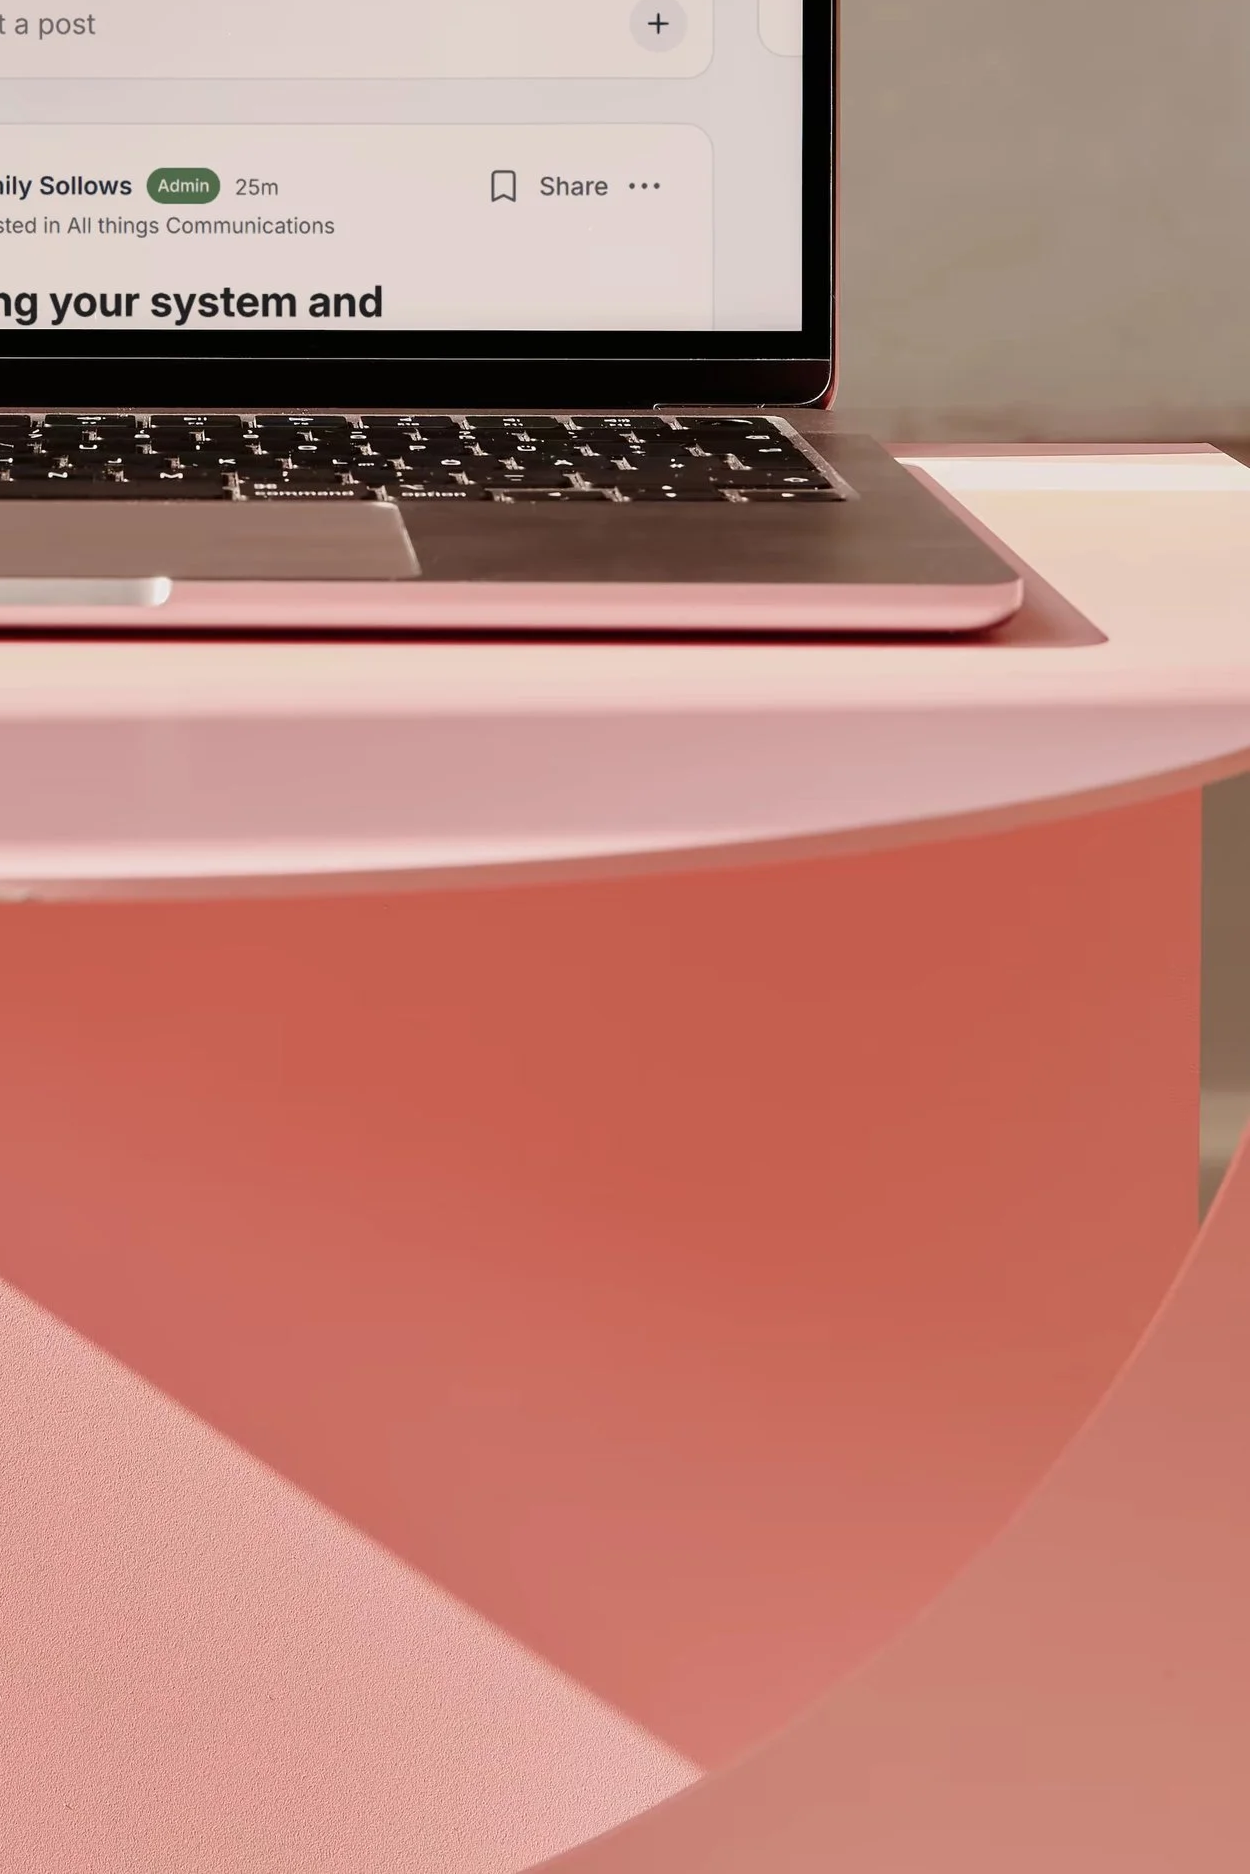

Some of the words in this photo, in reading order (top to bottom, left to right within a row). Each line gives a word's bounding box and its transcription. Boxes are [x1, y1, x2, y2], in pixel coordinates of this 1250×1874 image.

[14, 17, 29, 36] a
[38, 13, 96, 41] post
[39, 175, 133, 196] Sollows
[157, 177, 210, 194] Admin
[235, 178, 279, 196] 25m
[539, 176, 609, 197] Share
[43, 215, 61, 235] in
[67, 216, 92, 235] All
[97, 215, 160, 239] things
[165, 216, 335, 235] Communications
[49, 292, 141, 326] your
[150, 286, 297, 326] system
[308, 284, 383, 319] and
